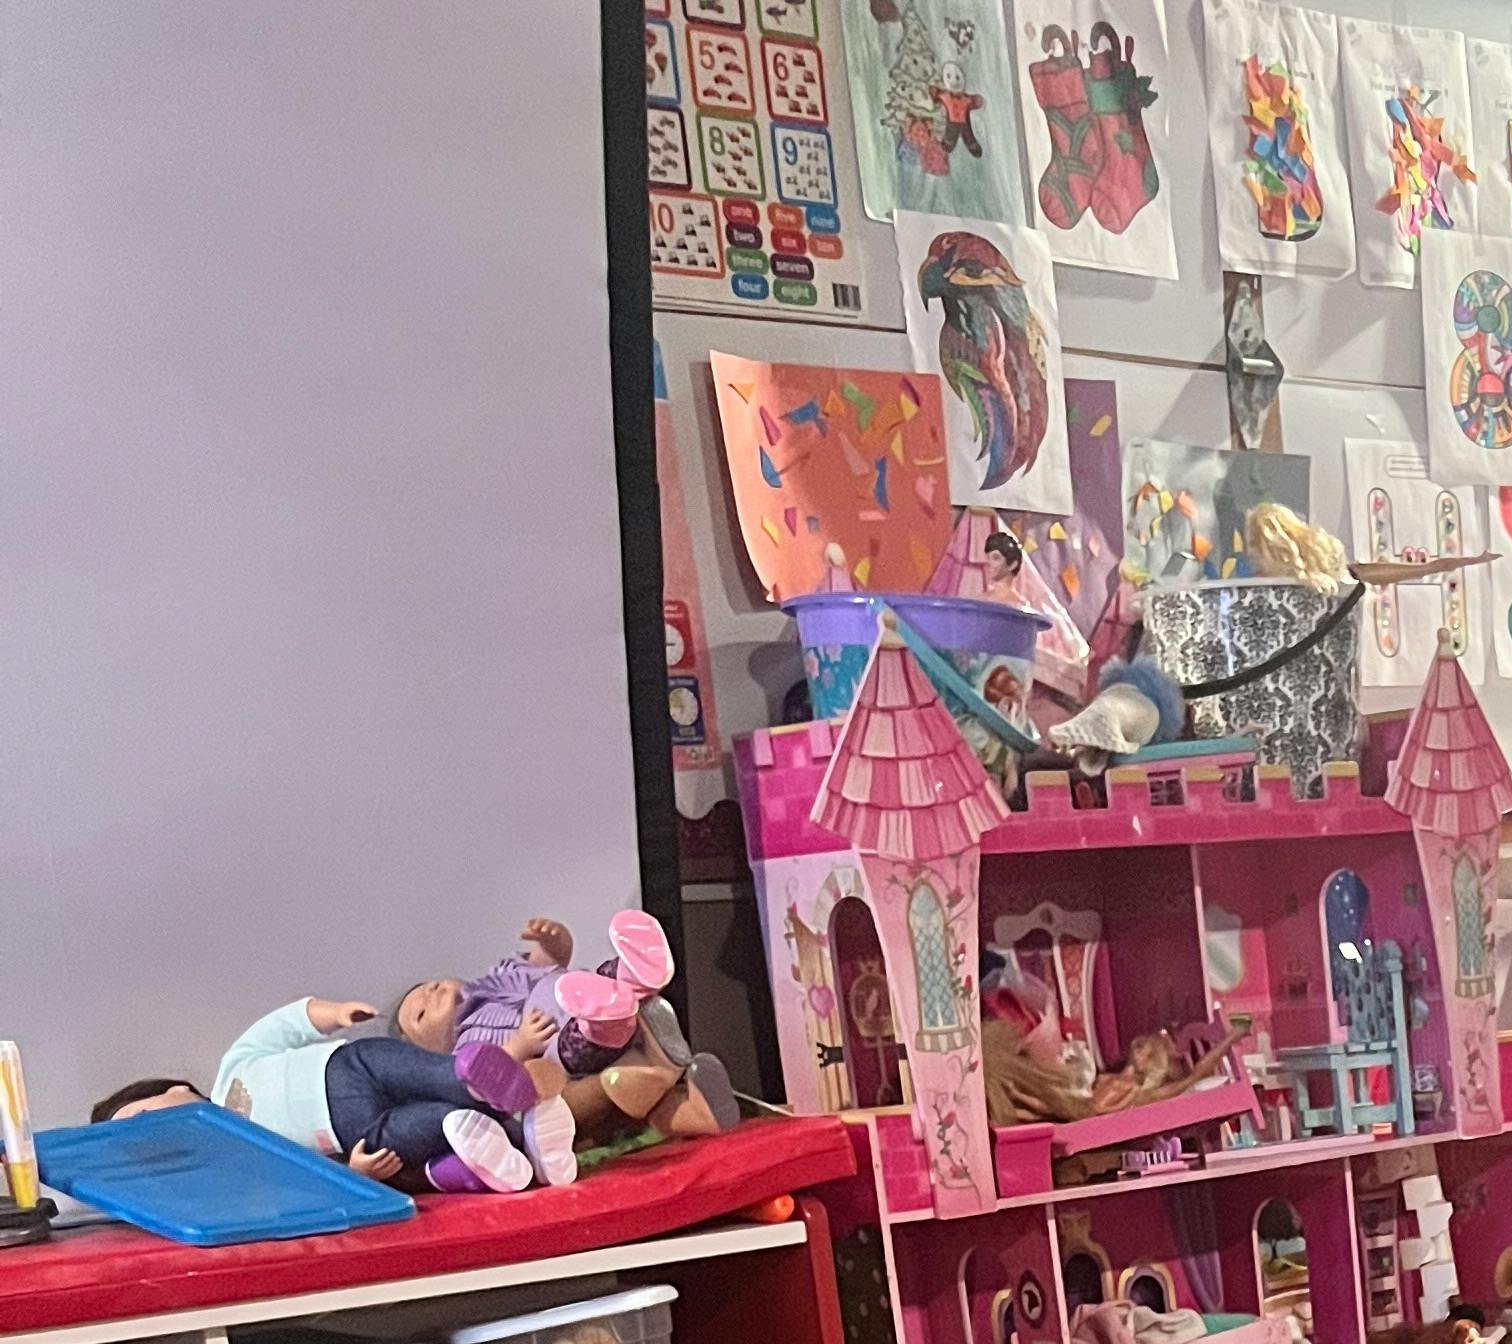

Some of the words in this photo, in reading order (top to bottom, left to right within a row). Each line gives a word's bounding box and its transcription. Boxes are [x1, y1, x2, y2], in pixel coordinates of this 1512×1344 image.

[700, 40, 715, 70] 5
[773, 52, 789, 81] 6
[708, 126, 726, 156] 8
[782, 136, 798, 166] 9
[733, 229, 755, 242] two
[732, 253, 763, 270] three
[776, 261, 809, 274] seven
[738, 280, 762, 294] four
[781, 285, 810, 301] eight
